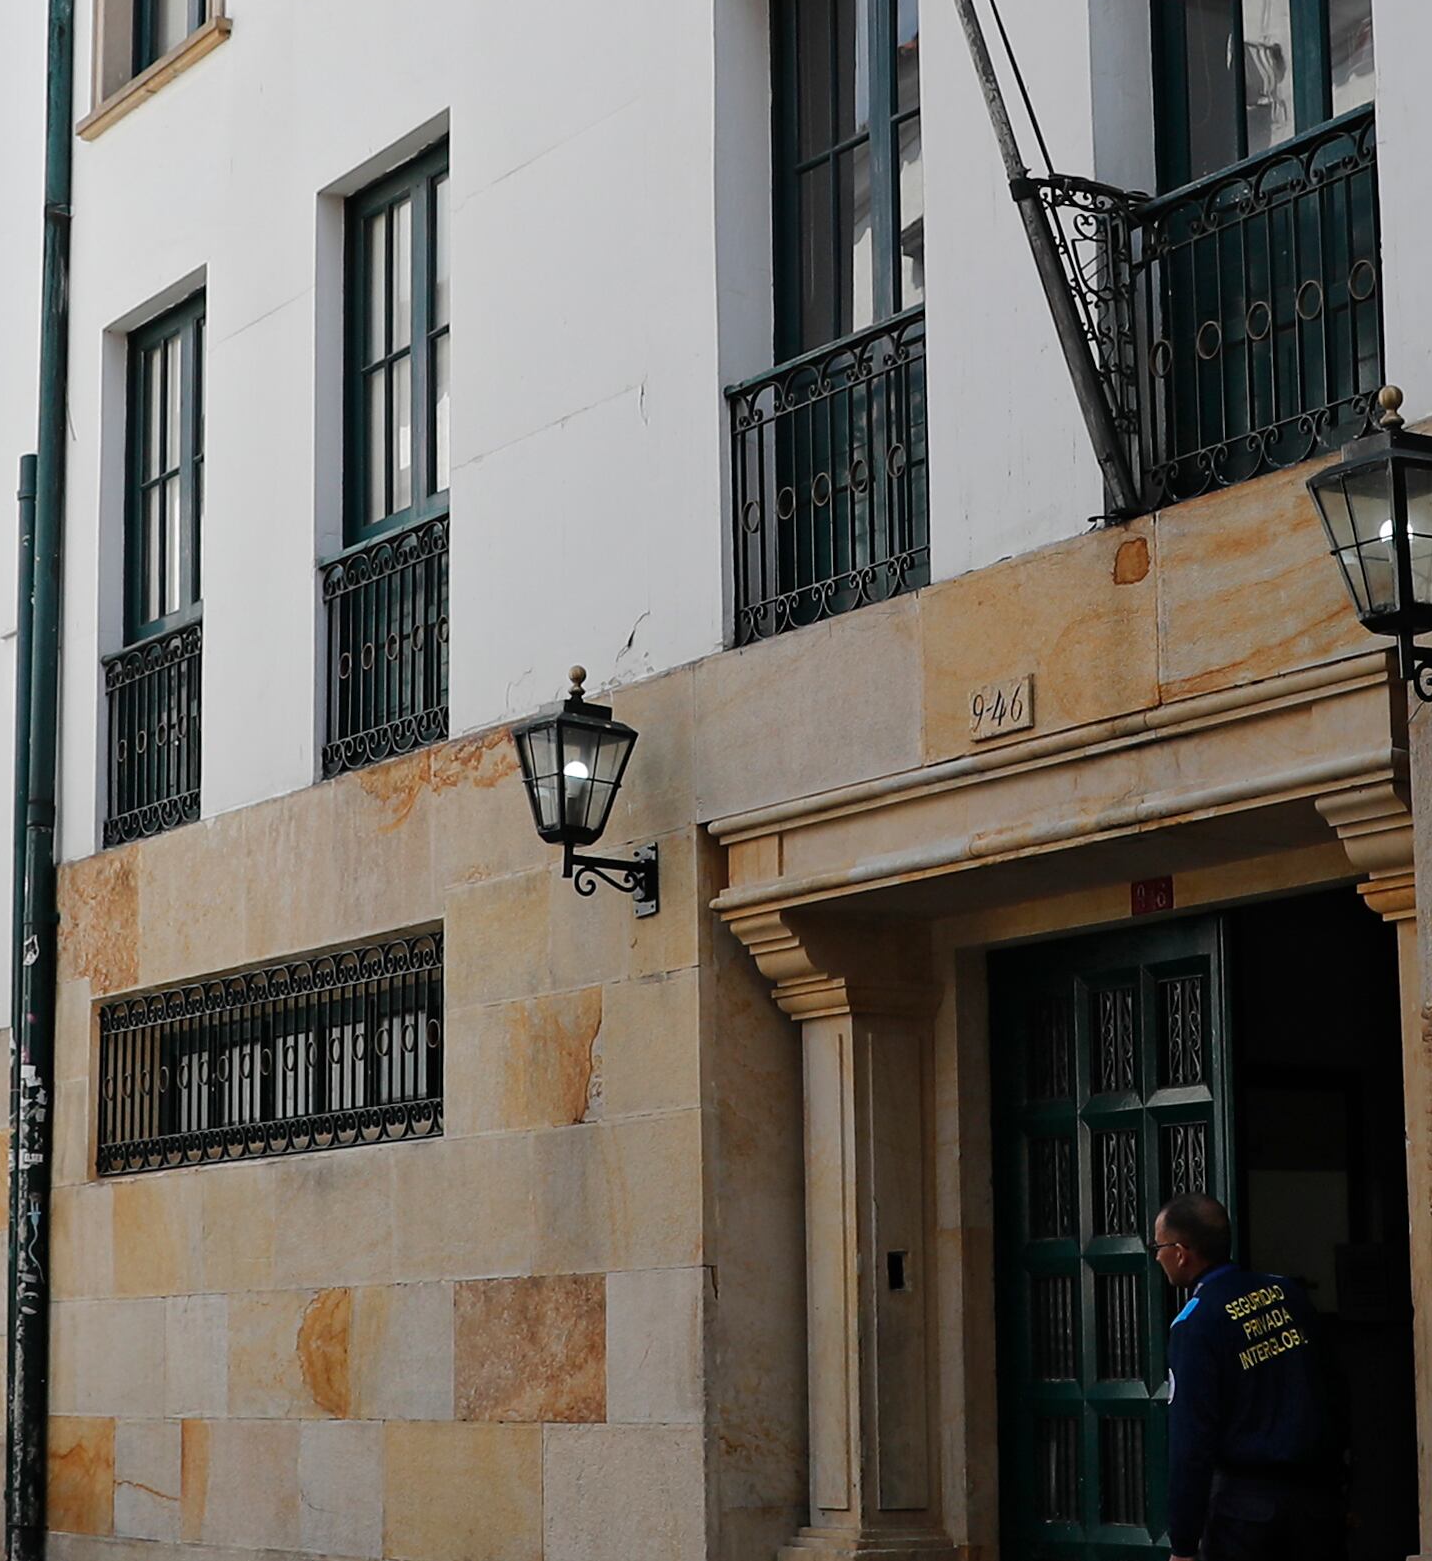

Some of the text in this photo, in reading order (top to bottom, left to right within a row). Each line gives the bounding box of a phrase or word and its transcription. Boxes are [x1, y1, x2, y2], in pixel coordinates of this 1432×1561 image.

[972, 682, 1023, 733] 9-46
[1224, 1284, 1285, 1321] SEGURIDAD
[1242, 1306, 1293, 1341] PRIVADA
[1238, 1328, 1309, 1371] INTERGLOB
